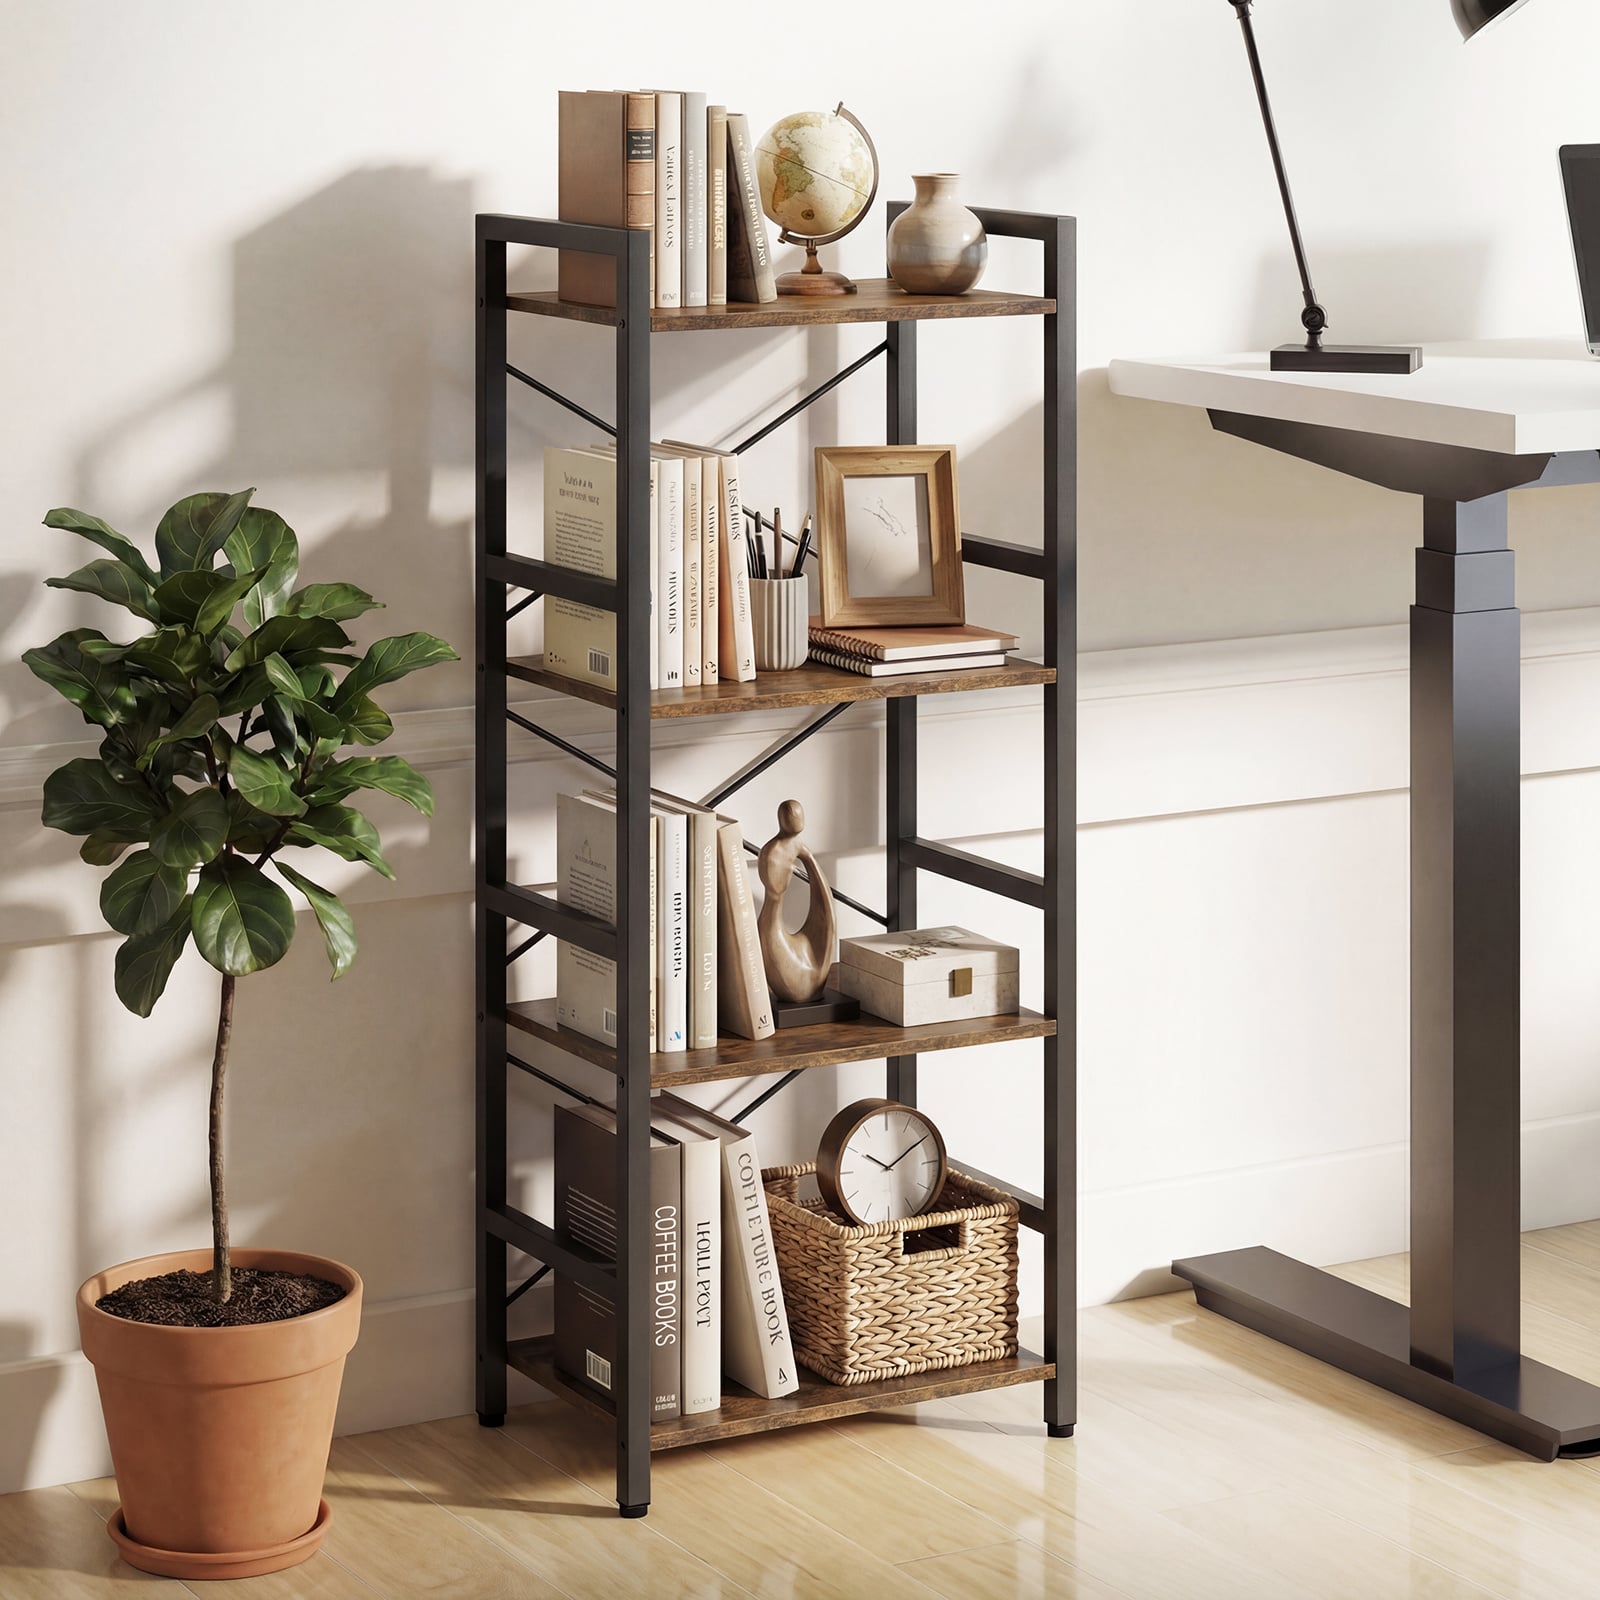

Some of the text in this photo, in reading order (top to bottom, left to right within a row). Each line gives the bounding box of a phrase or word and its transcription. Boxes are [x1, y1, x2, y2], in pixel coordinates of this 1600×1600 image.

[654, 1205, 677, 1347] COFFEE BOOKS
[761, 1288, 784, 1346] BOOK
